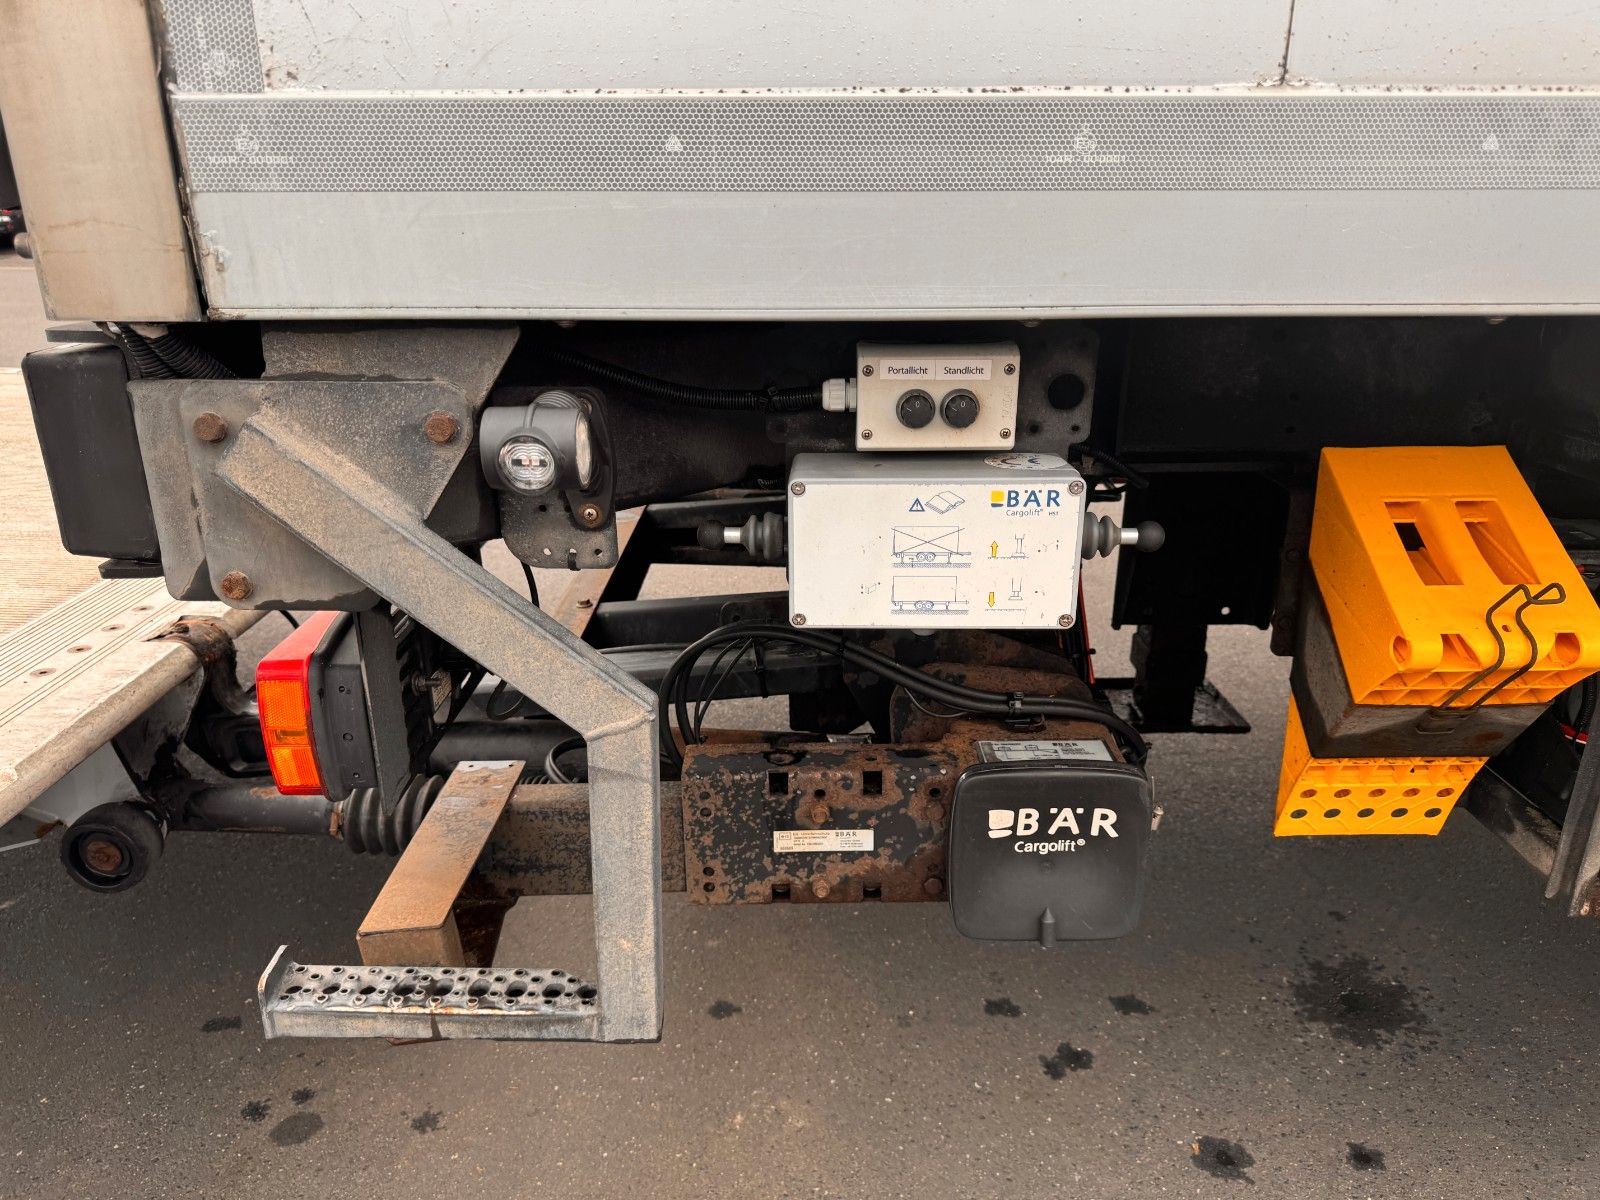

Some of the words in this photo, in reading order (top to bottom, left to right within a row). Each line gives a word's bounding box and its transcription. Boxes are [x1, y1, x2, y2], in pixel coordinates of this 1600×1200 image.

[887, 366, 929, 376] Portallicht
[943, 366, 984, 376] Standlicht
[1006, 489, 1060, 508] BÄR
[1016, 807, 1119, 838] BÄR
